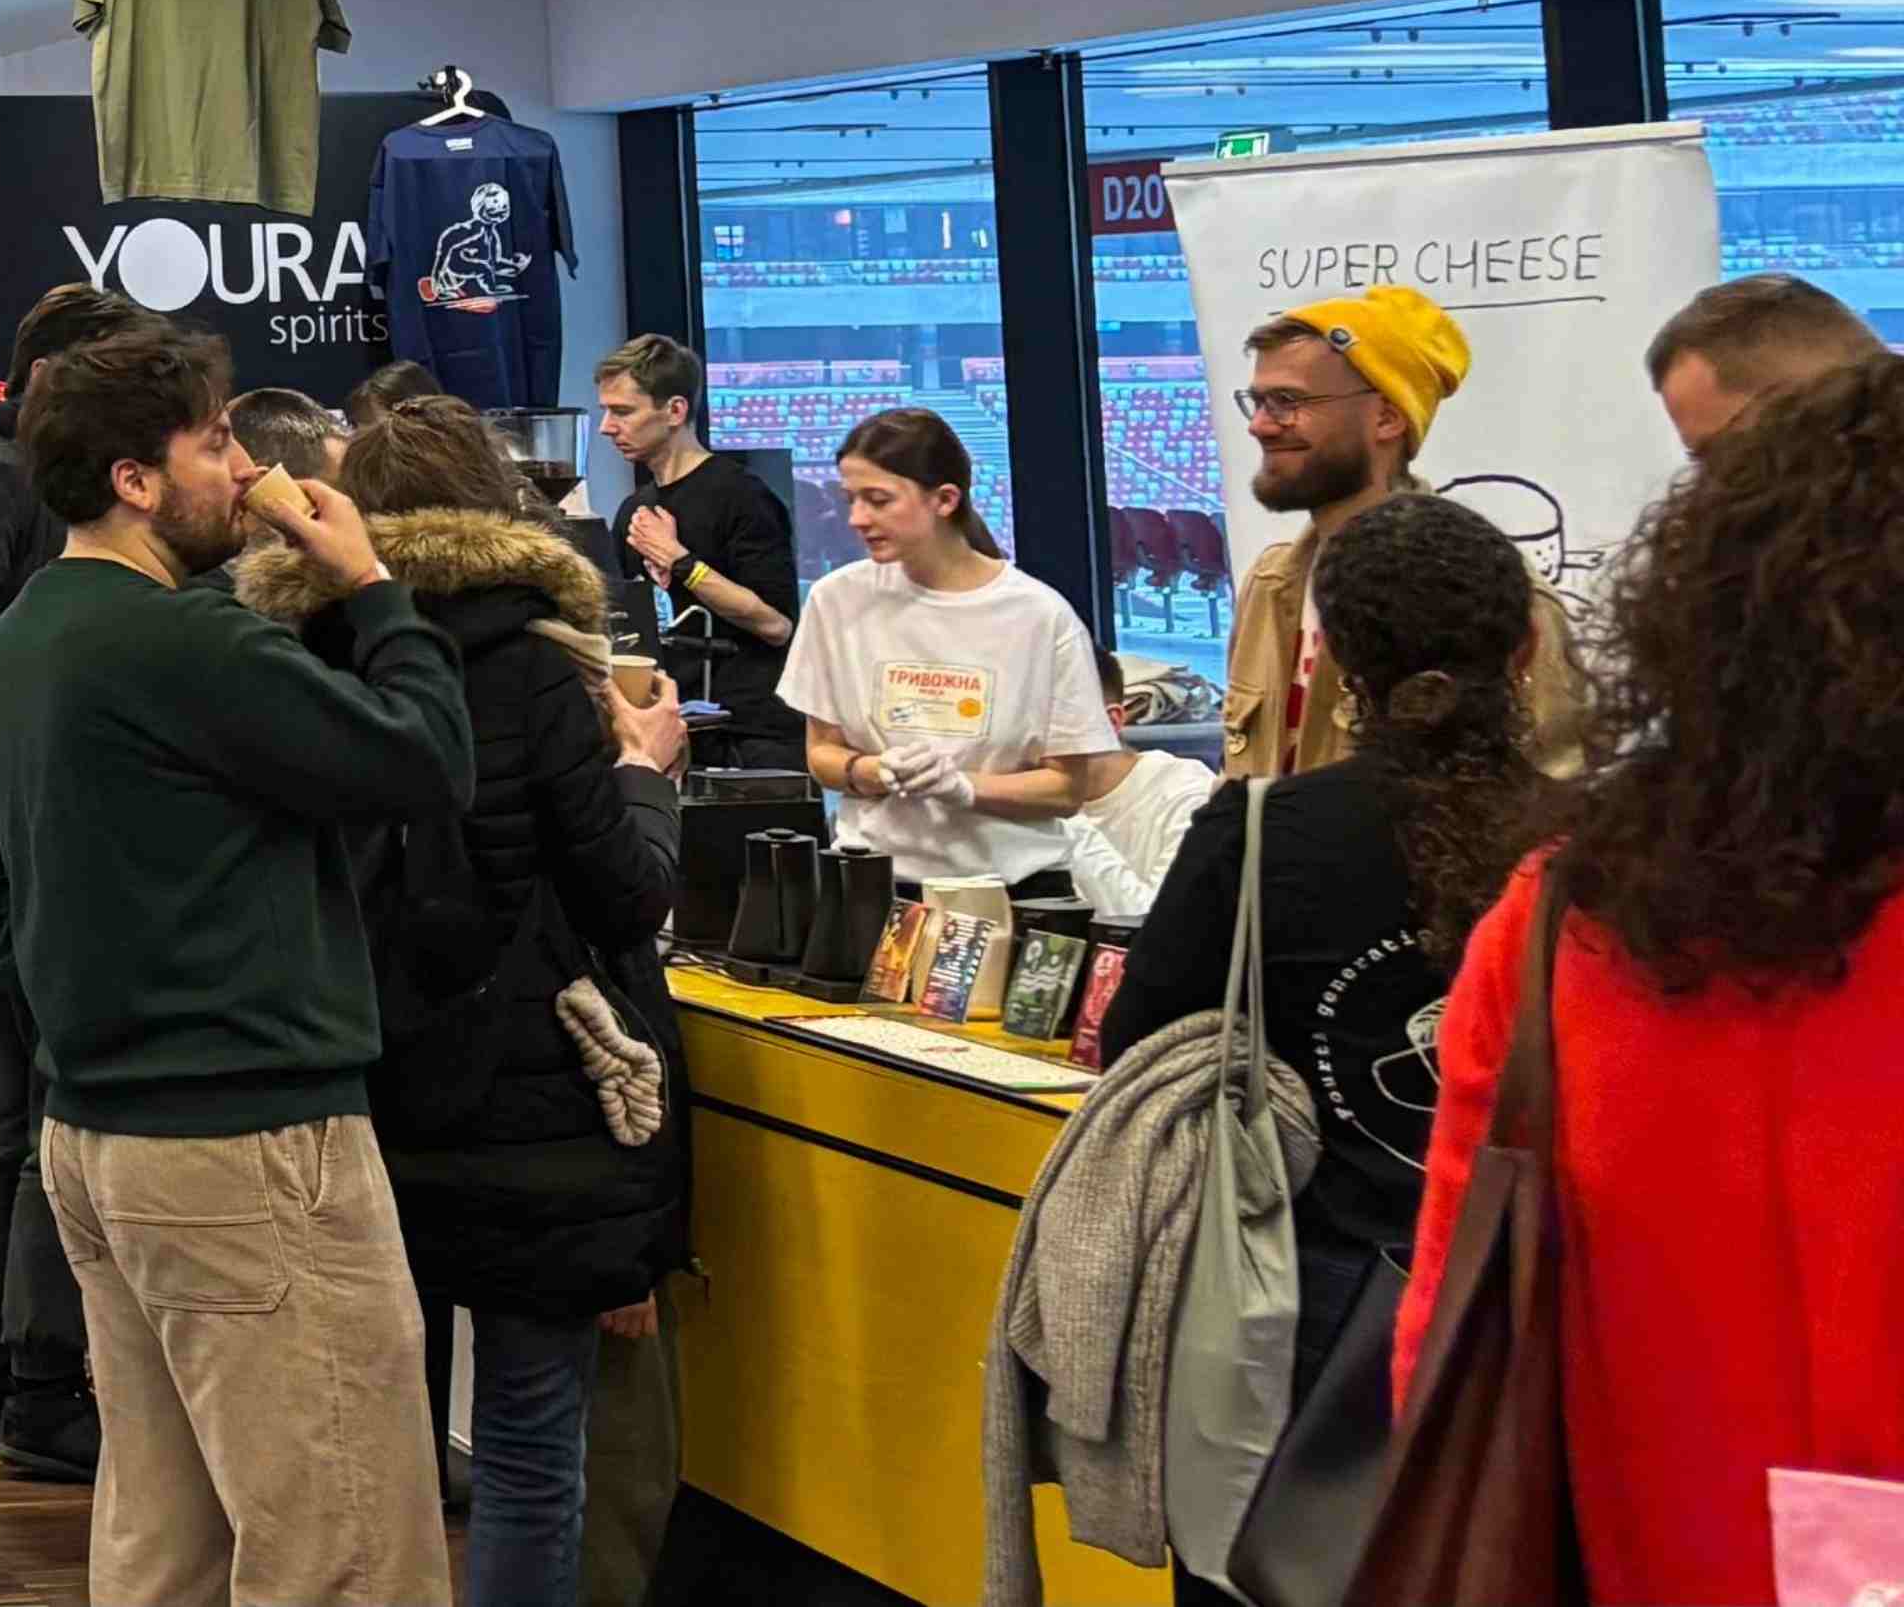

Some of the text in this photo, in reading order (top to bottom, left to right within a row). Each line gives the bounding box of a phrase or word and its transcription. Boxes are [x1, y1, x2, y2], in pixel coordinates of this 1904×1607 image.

[1103, 173, 1165, 222] D20
[62, 217, 385, 312] YOURA
[1258, 234, 1603, 289] SUPER CHEESE
[270, 305, 390, 355] spirits
[887, 669, 982, 691] ТРИВОЖНА
